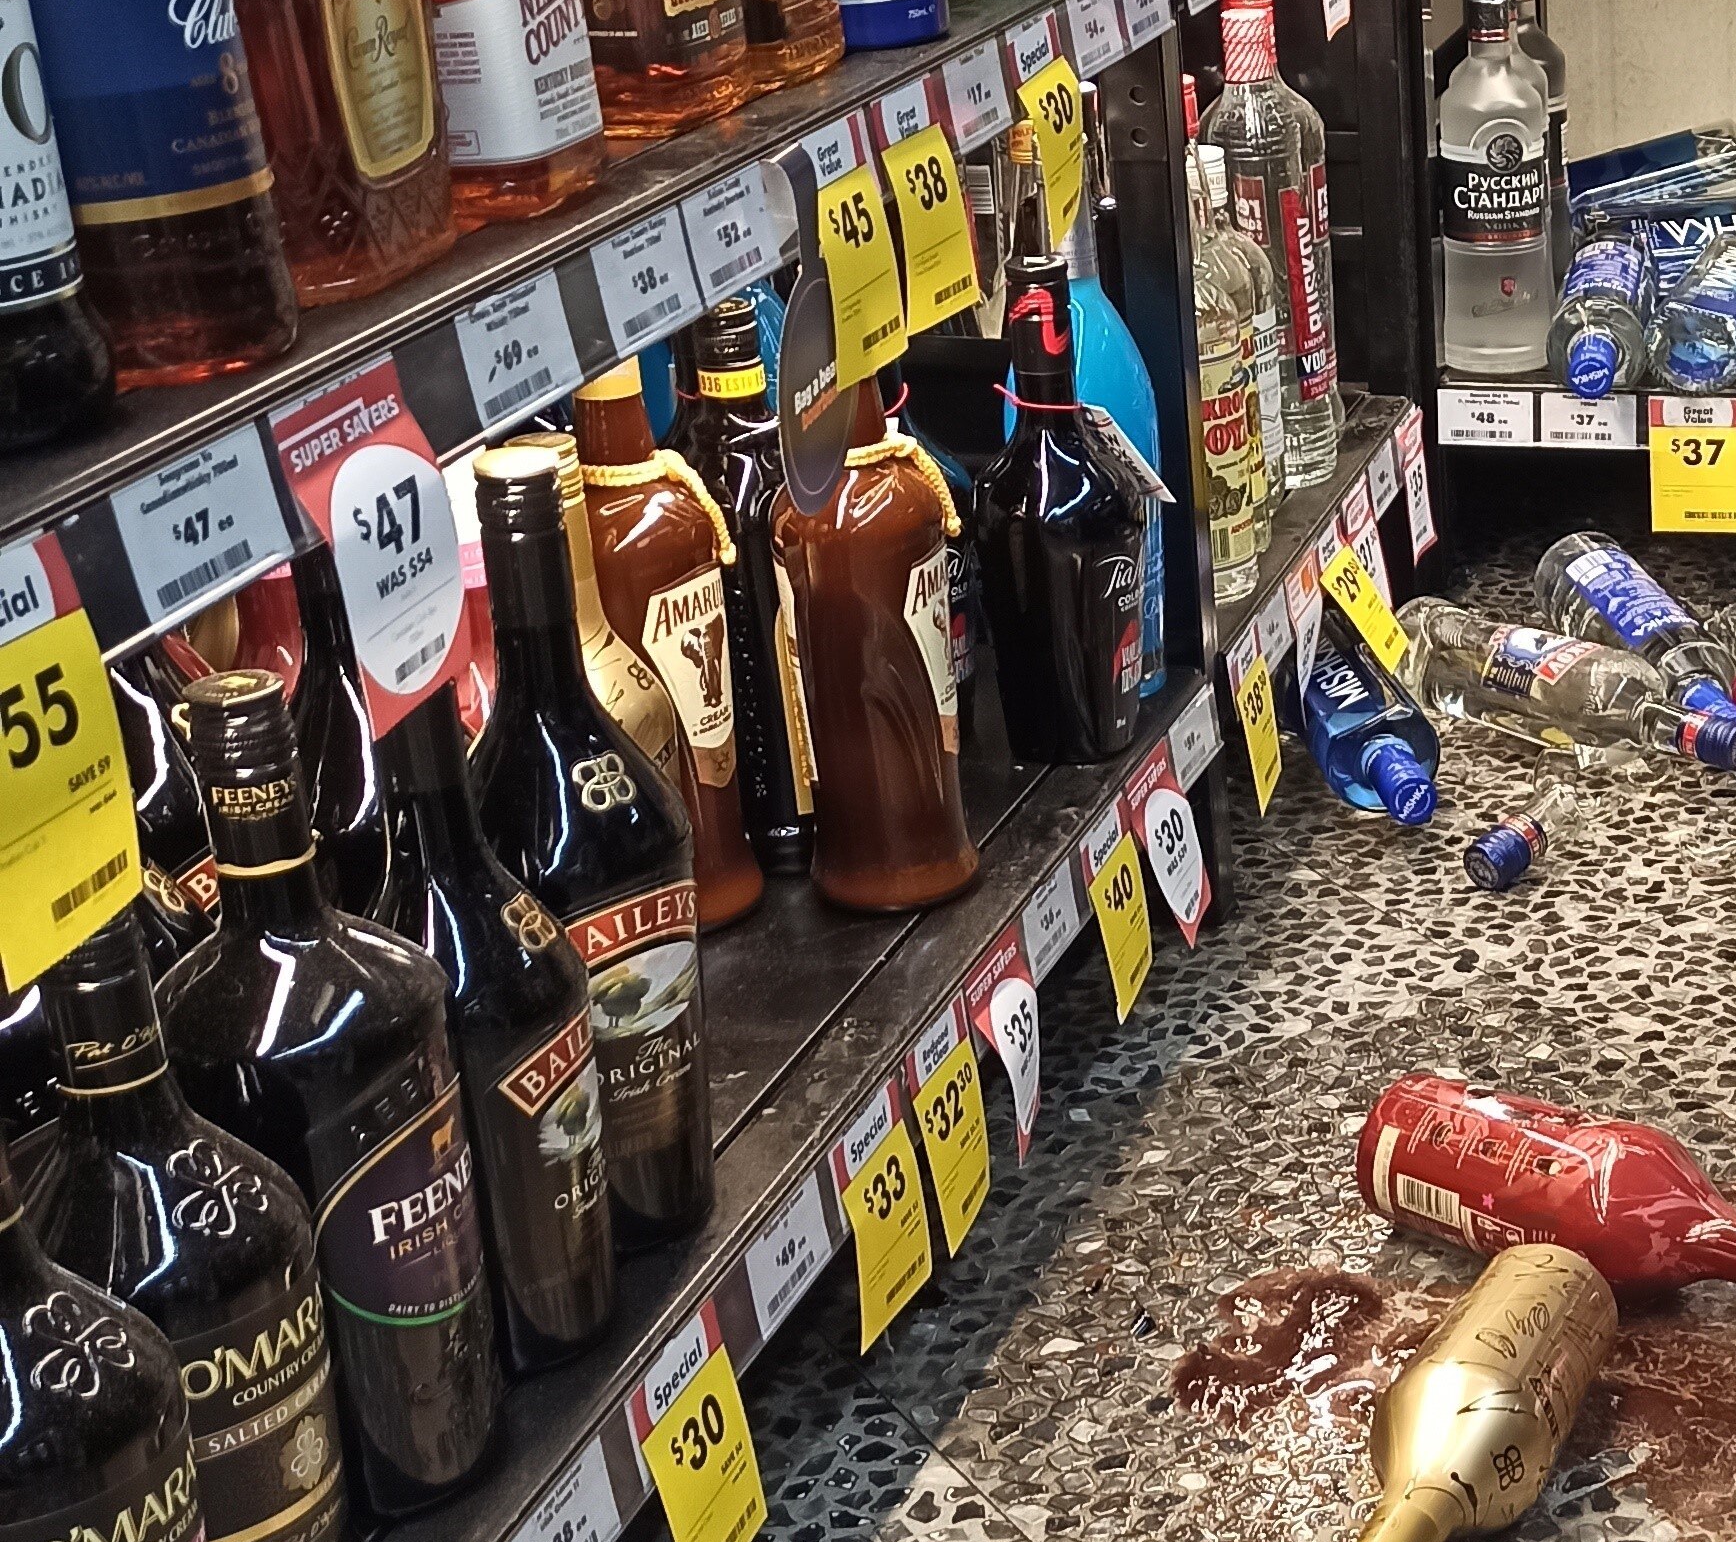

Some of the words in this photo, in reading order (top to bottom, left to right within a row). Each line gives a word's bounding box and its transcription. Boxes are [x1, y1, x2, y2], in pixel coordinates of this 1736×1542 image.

[1041, 82, 1074, 134] $30
[907, 155, 948, 210] $38
[829, 192, 874, 248] $45
[289, 433, 341, 473] SUPER
[343, 393, 400, 440] SAVERS
[1470, 412, 1495, 425] $48
[1671, 437, 1726, 467] $37
[172, 509, 211, 547] $47
[353, 474, 423, 555] $47
[376, 568, 407, 600] WAS
[407, 547, 434, 588] $54
[1103, 863, 1135, 913] $40
[863, 1154, 907, 1223] $33
[388, 1217, 448, 1260] IRISH
[652, 1337, 704, 1412] Special
[207, 1406, 289, 1455] SALTED
[671, 1394, 725, 1473] $30
